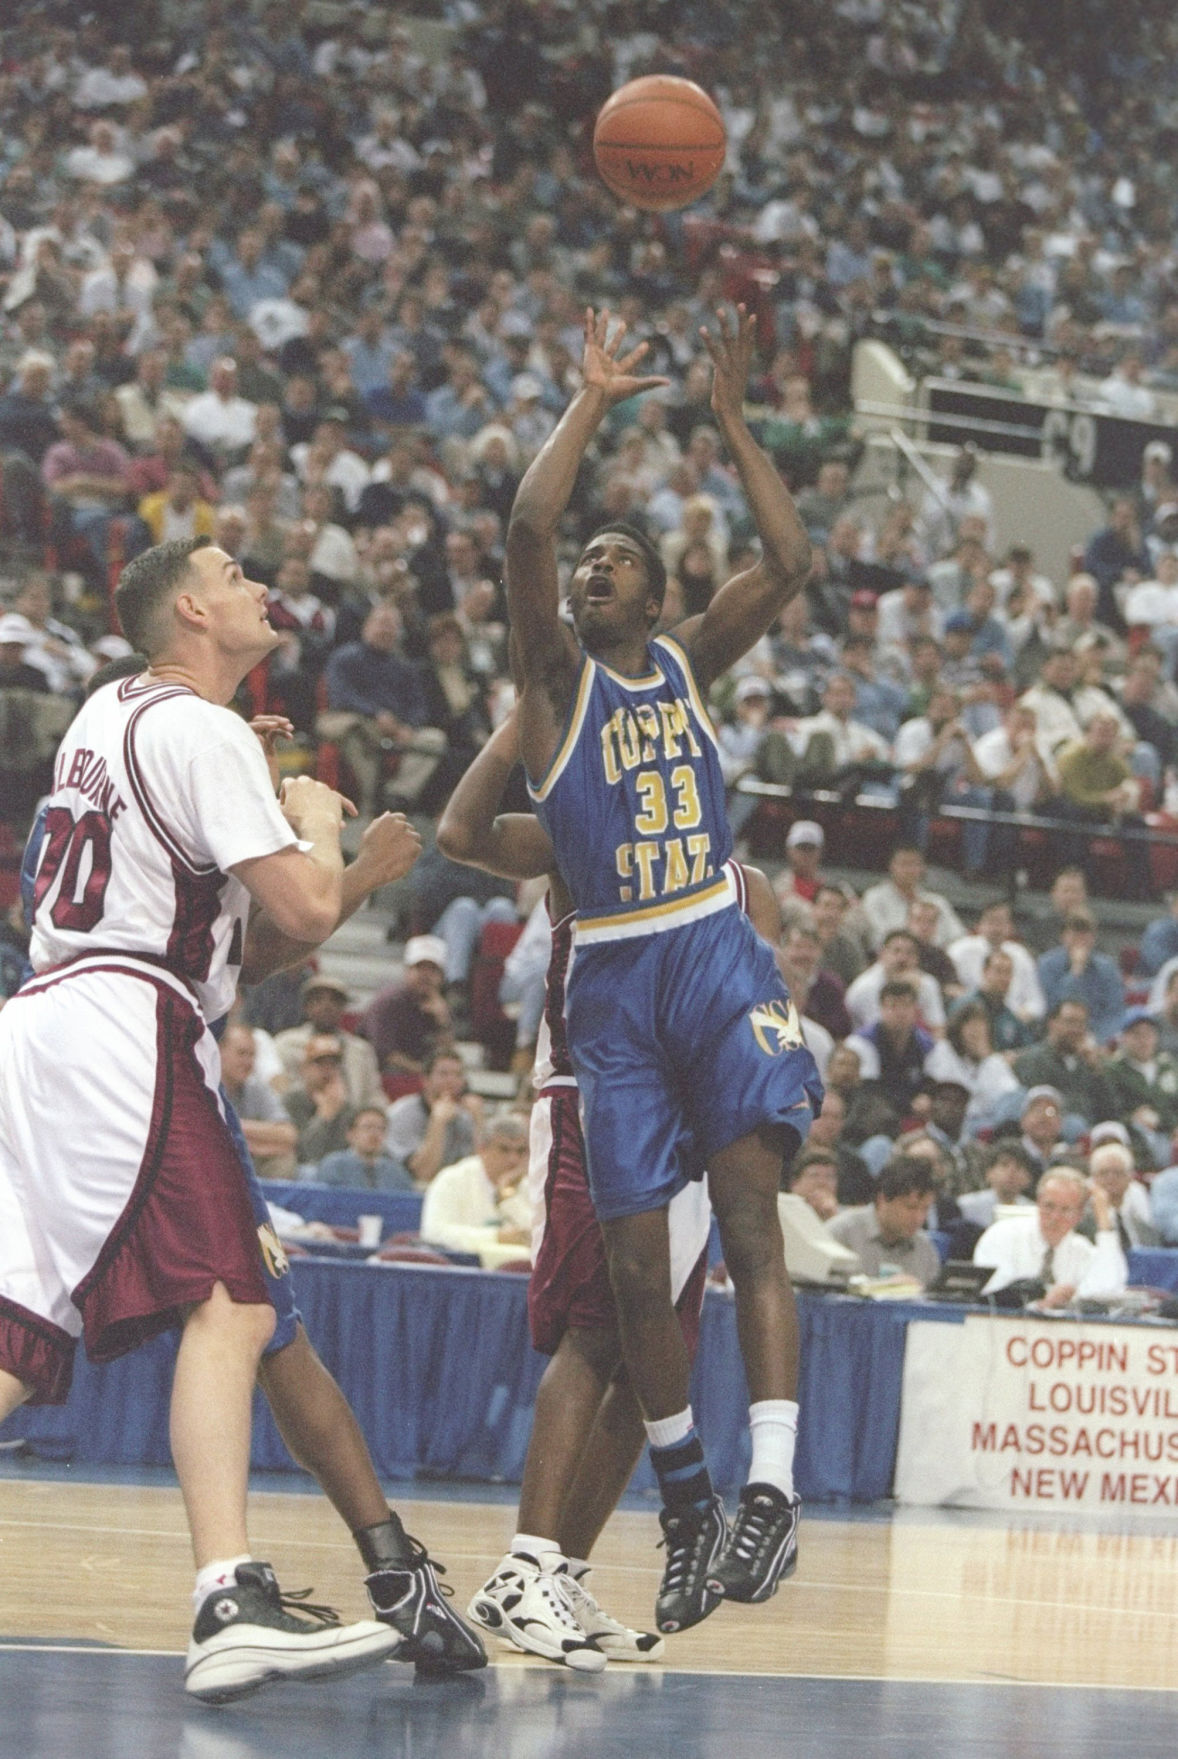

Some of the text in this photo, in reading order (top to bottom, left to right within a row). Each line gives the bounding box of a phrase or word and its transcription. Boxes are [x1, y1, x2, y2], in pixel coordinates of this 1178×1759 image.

[50, 747, 128, 820] LBOURNE
[635, 764, 702, 835] 33
[615, 832, 714, 903] STAT
[1006, 1336, 1128, 1371] COPPIN
[1028, 1382, 1178, 1418] LOUISVIL
[1010, 1467, 1089, 1499] NEW
